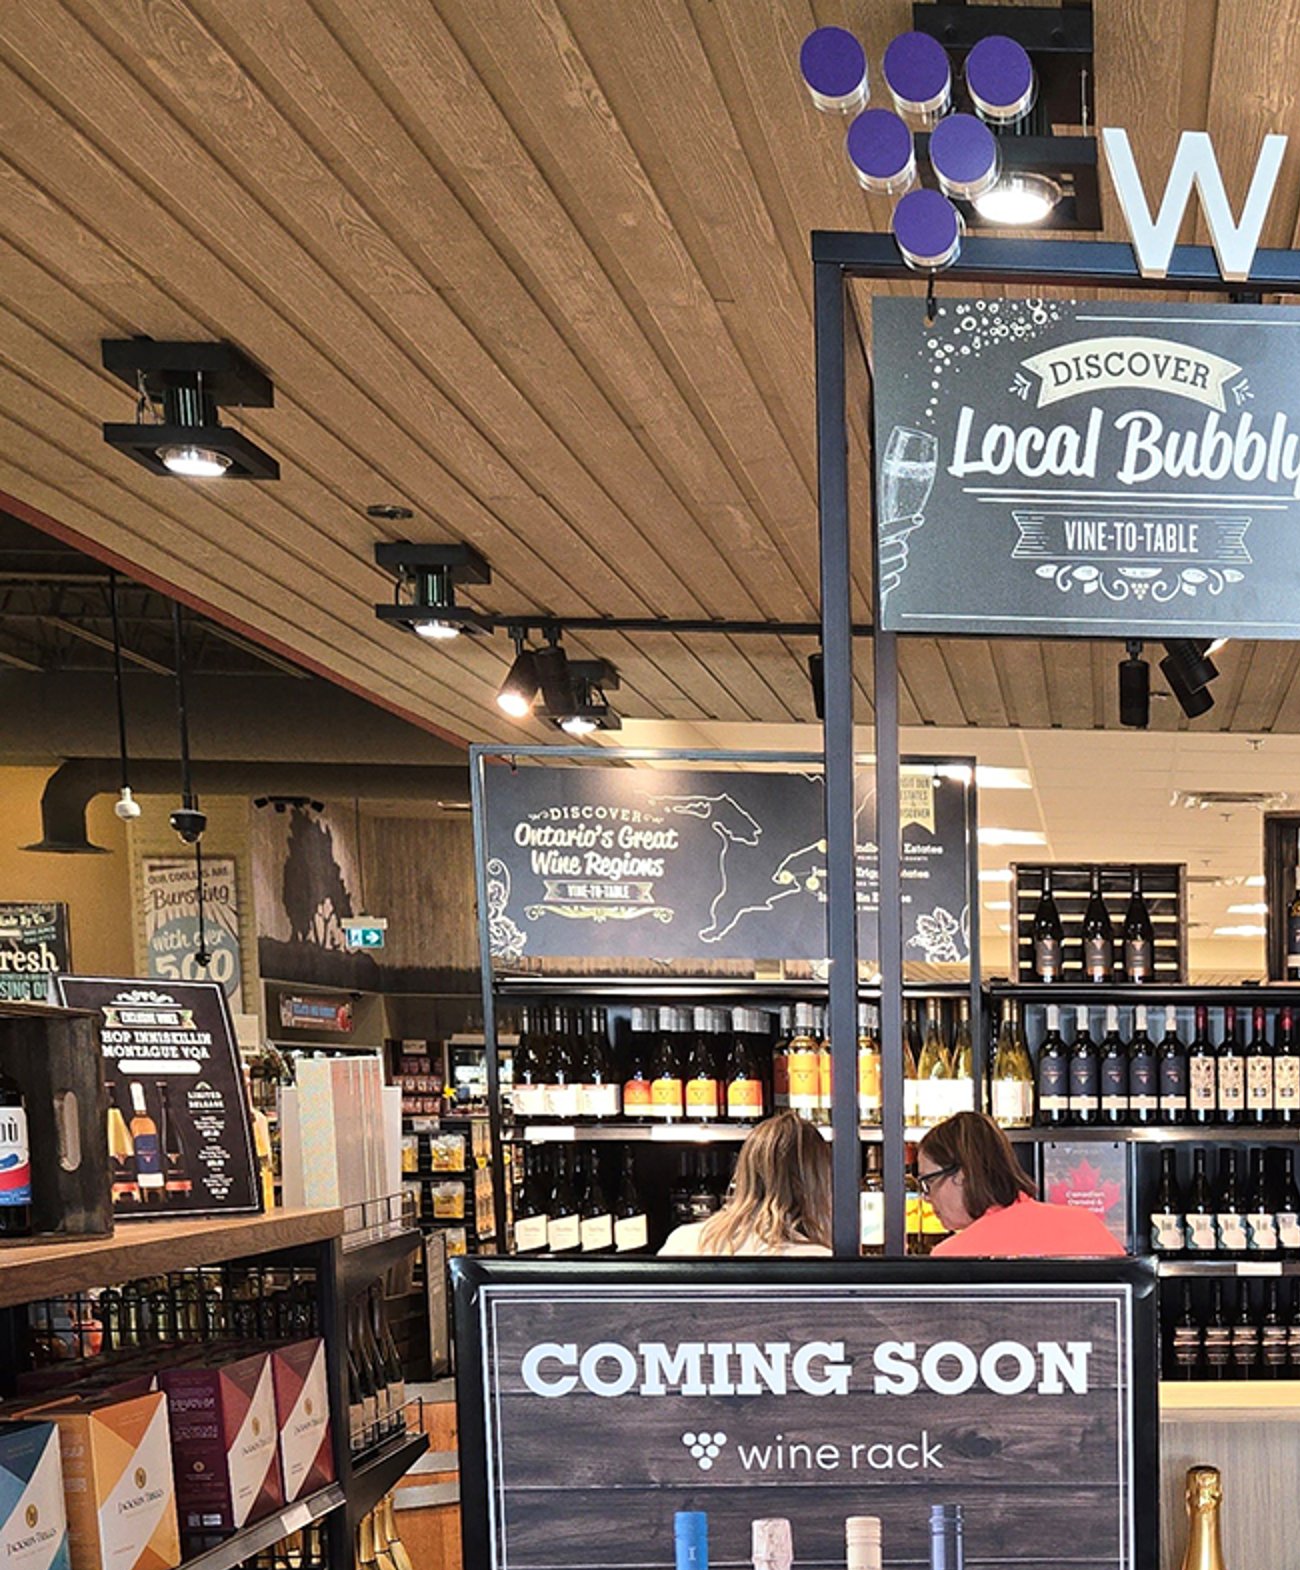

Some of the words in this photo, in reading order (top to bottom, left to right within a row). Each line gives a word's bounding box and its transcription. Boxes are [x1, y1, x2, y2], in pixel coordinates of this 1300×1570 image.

[1050, 352, 1212, 390] DISCOVER
[948, 407, 1104, 479] Local
[1064, 521, 1199, 553] VINE-TO-TABLE
[550, 806, 642, 823] DISCOVER
[514, 822, 614, 848] Ontario's
[617, 824, 679, 850] Great
[531, 850, 582, 875] Wine
[584, 850, 665, 881] Regions
[147, 882, 229, 911] Bursing
[152, 929, 191, 953] with
[0, 942, 60, 973] resh
[155, 949, 235, 982] 500
[0, 981, 31, 999] SING
[101, 1029, 132, 1044] HOP
[520, 1340, 852, 1397] COMING
[873, 1340, 1093, 1396] SOON
[737, 1434, 840, 1471] wine
[850, 1430, 944, 1470] rack
